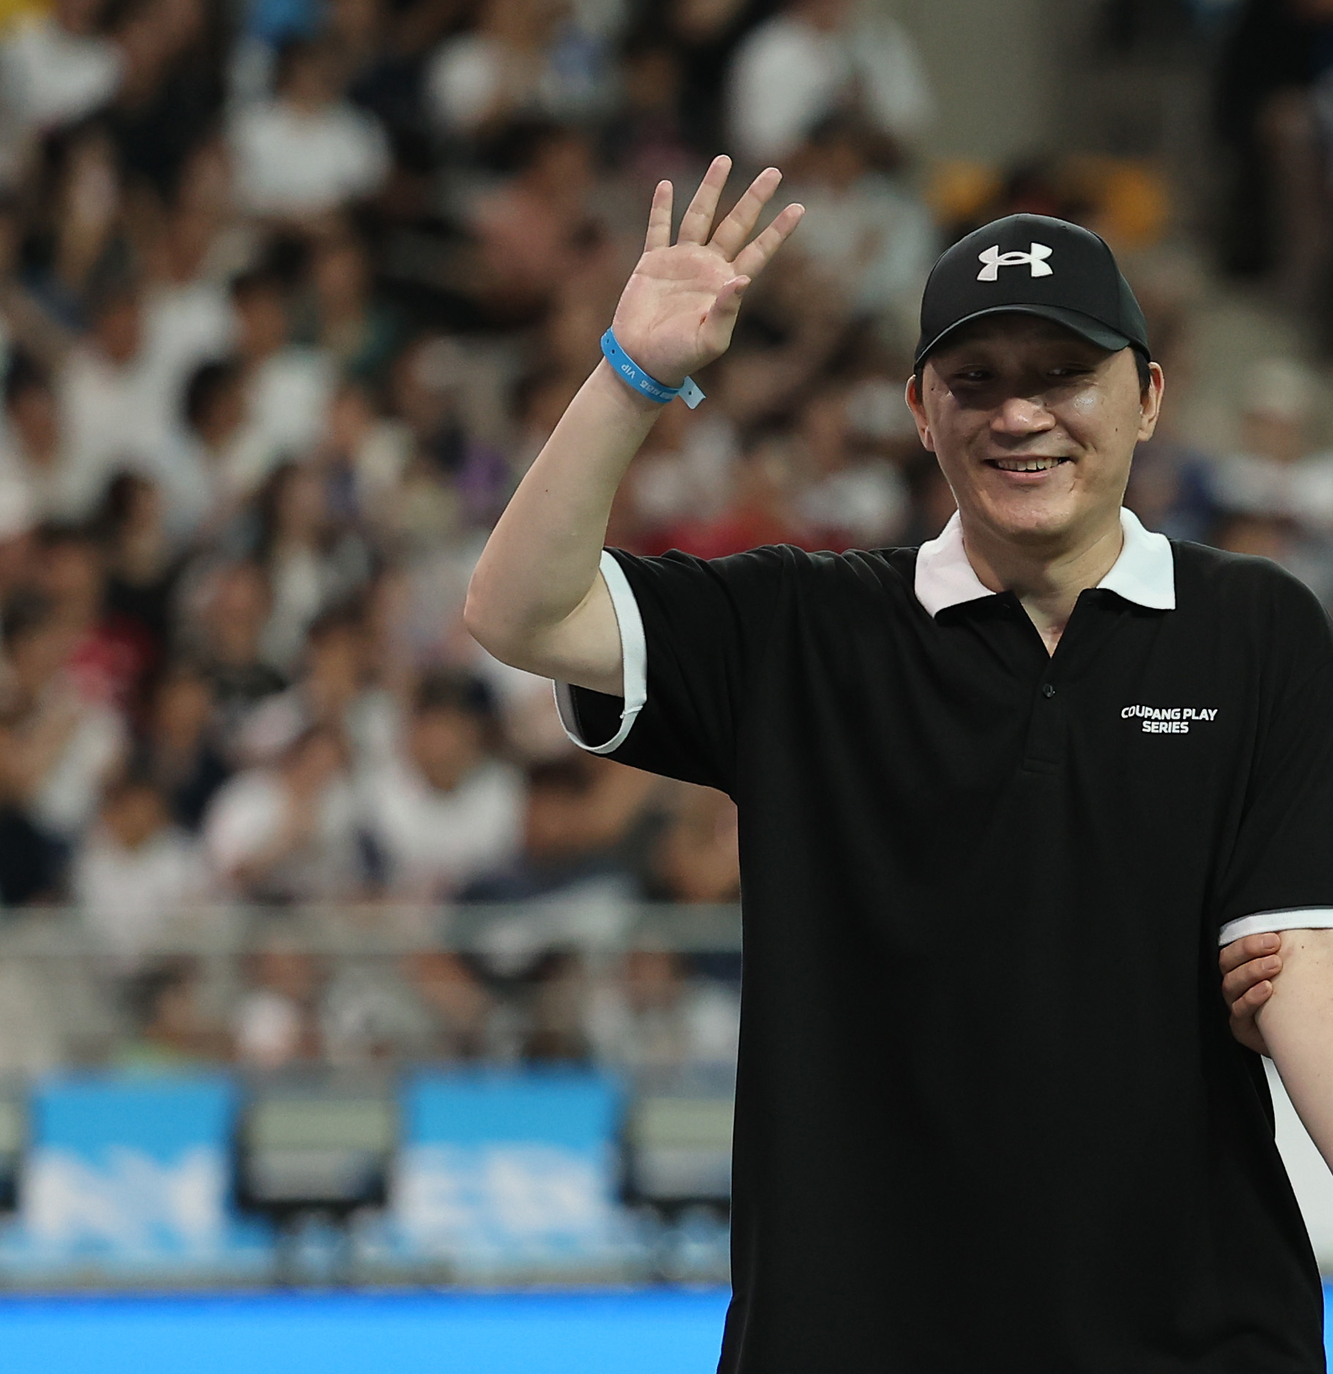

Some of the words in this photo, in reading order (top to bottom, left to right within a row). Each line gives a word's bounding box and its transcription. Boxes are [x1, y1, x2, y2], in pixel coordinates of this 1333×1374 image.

[621, 364, 635, 379] VIP
[1121, 705, 1181, 720] COUPANG
[1182, 708, 1218, 721] PLAY
[1142, 721, 1189, 733] SERIES
